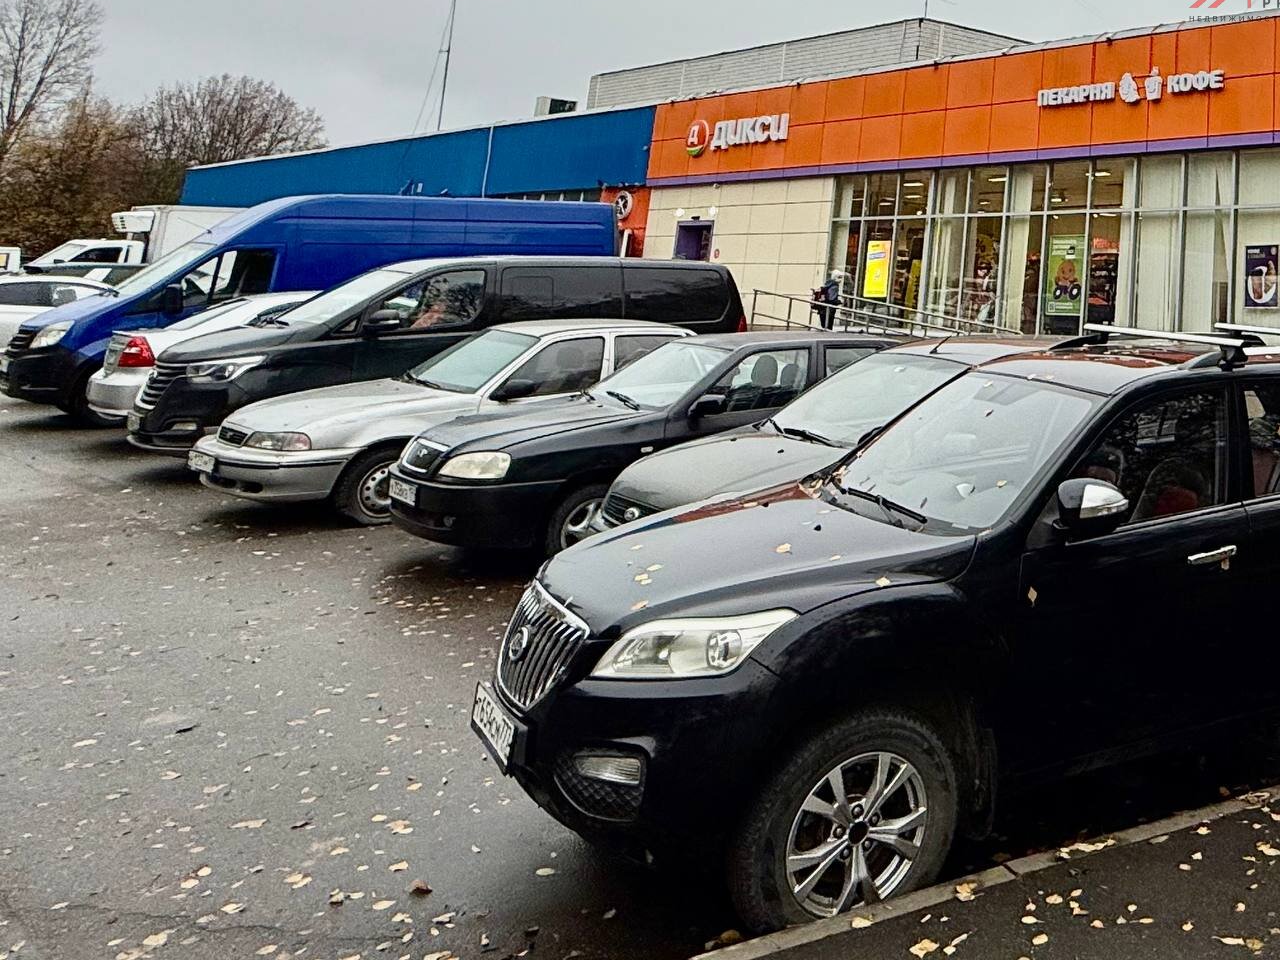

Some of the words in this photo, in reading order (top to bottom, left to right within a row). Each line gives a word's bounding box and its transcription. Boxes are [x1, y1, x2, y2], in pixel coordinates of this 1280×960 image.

[1037, 81, 1116, 107] ПЕКАРНЯ
[1167, 69, 1225, 93] КОФЕ
[710, 113, 790, 150] ДИКСИ
